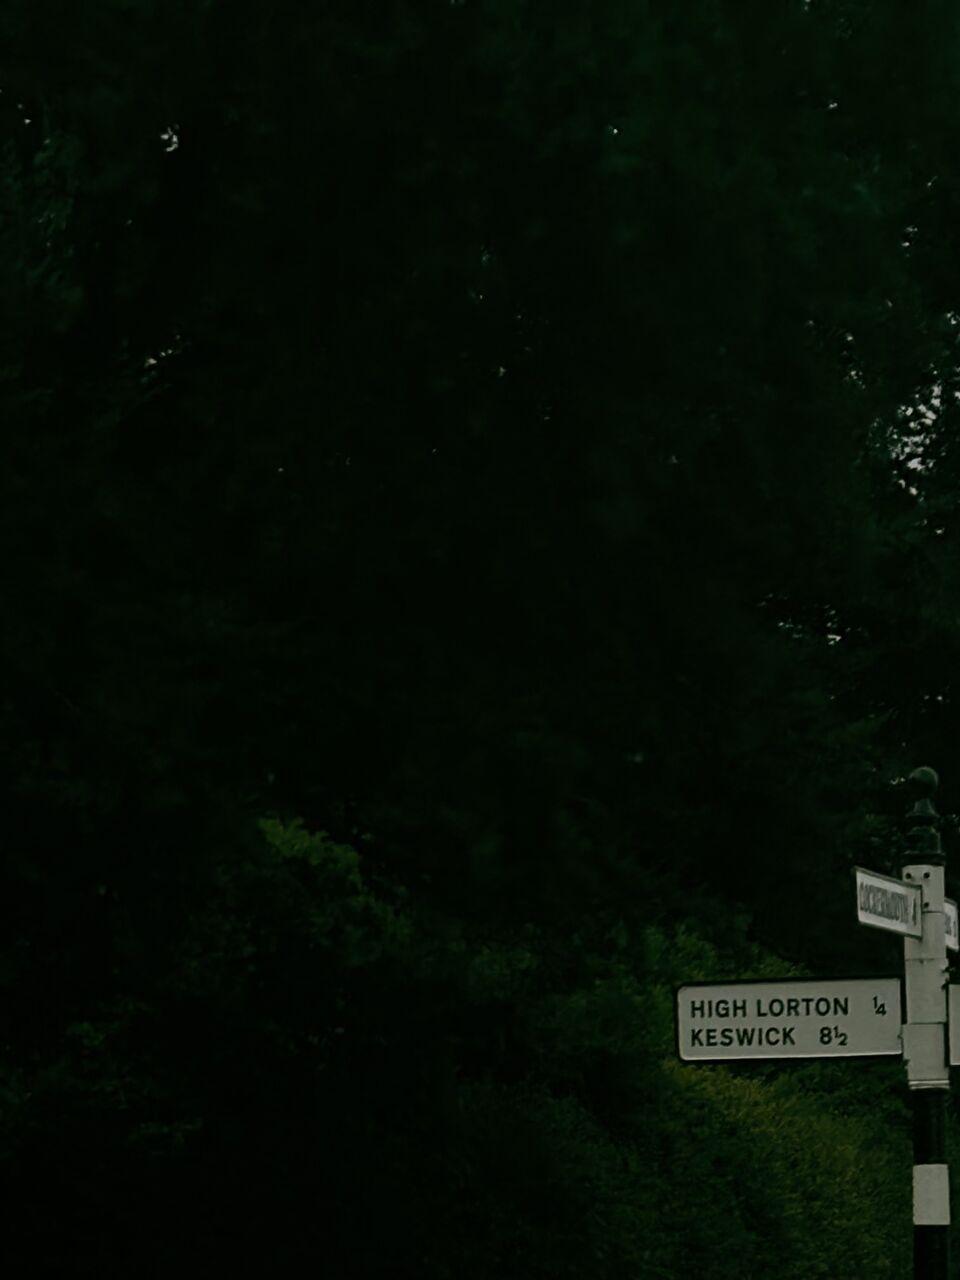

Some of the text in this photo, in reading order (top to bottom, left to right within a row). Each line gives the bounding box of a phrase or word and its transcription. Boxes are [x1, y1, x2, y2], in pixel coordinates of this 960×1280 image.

[690, 998, 747, 1019] HIGH
[756, 997, 849, 1017] LORTON
[691, 1027, 796, 1047] KESWICK
